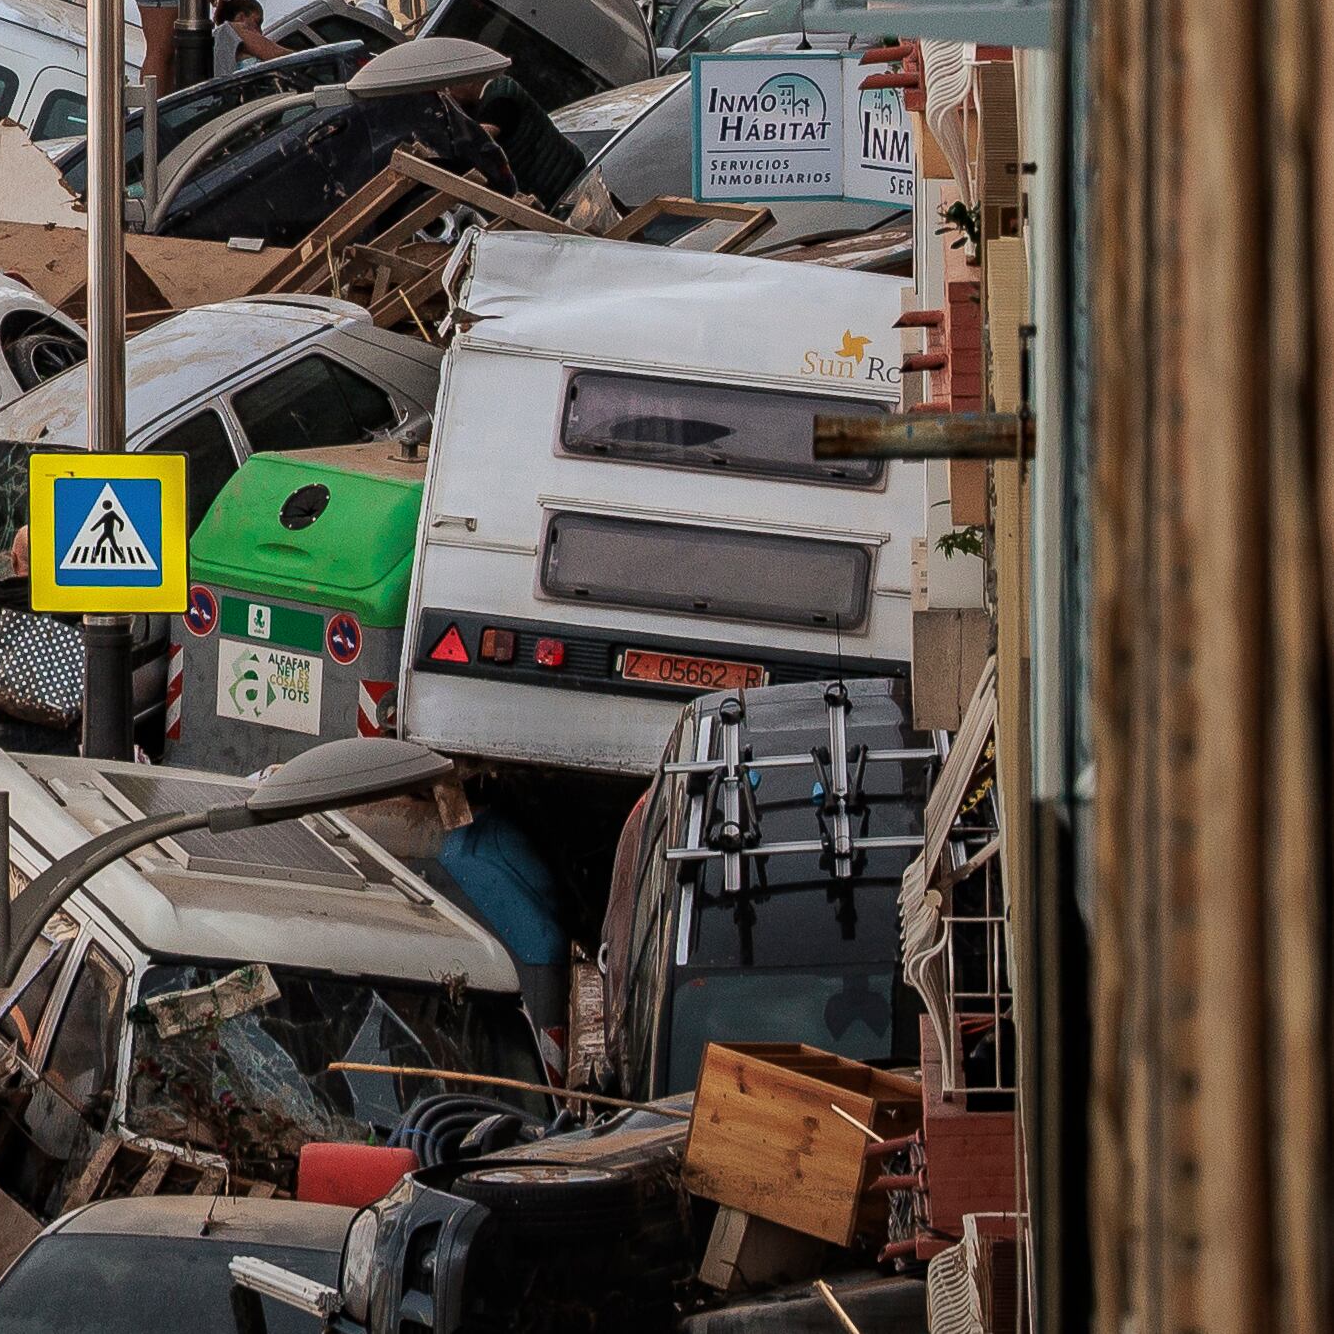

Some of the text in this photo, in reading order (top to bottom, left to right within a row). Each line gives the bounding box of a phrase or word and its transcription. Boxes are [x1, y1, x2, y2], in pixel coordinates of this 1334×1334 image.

[708, 87, 778, 114] INMO
[719, 116, 832, 142] HÁBITAT
[710, 159, 790, 171] SERVICIOS
[710, 172, 832, 186] INMOBILIARIOS
[800, 350, 855, 379] Sun
[268, 652, 311, 673] ALFAFAR
[626, 655, 761, 689] Z 05662 R
[282, 686, 310, 704] TOTS
